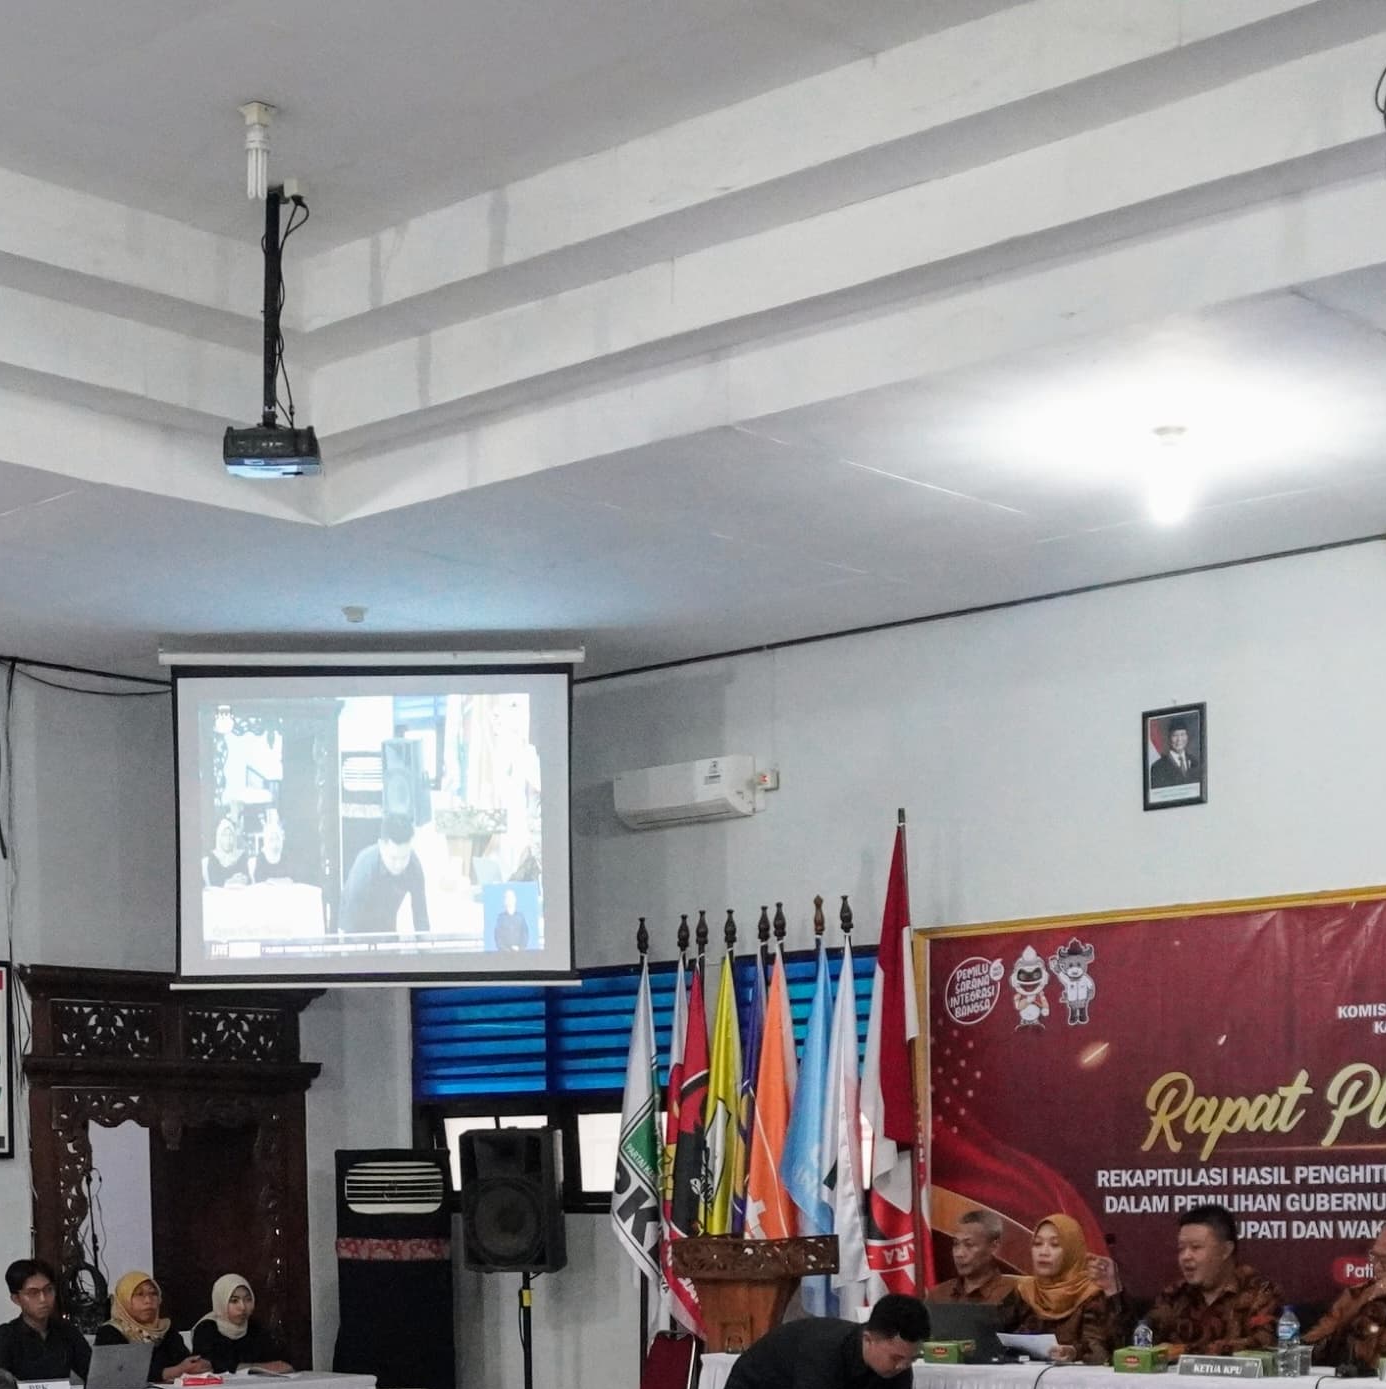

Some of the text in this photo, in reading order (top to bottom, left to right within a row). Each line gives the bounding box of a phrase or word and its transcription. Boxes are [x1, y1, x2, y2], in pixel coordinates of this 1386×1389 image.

[956, 963, 989, 982] PEMILU
[955, 974, 990, 995] SARANA
[950, 985, 995, 1009] INTEGRASI
[955, 998, 991, 1018] BANGSA
[1141, 1069, 1313, 1161] Rapat
[1097, 1167, 1229, 1189] REKAPITULASI
[1233, 1167, 1291, 1186] HASIL
[1105, 1194, 1169, 1214] DALAM
[1174, 1193, 1281, 1213] PEMILIHAN
[1236, 1221, 1287, 1241] UPATI
[1291, 1220, 1334, 1240] DAN
[1193, 1363, 1242, 1375] KETUA KPU
